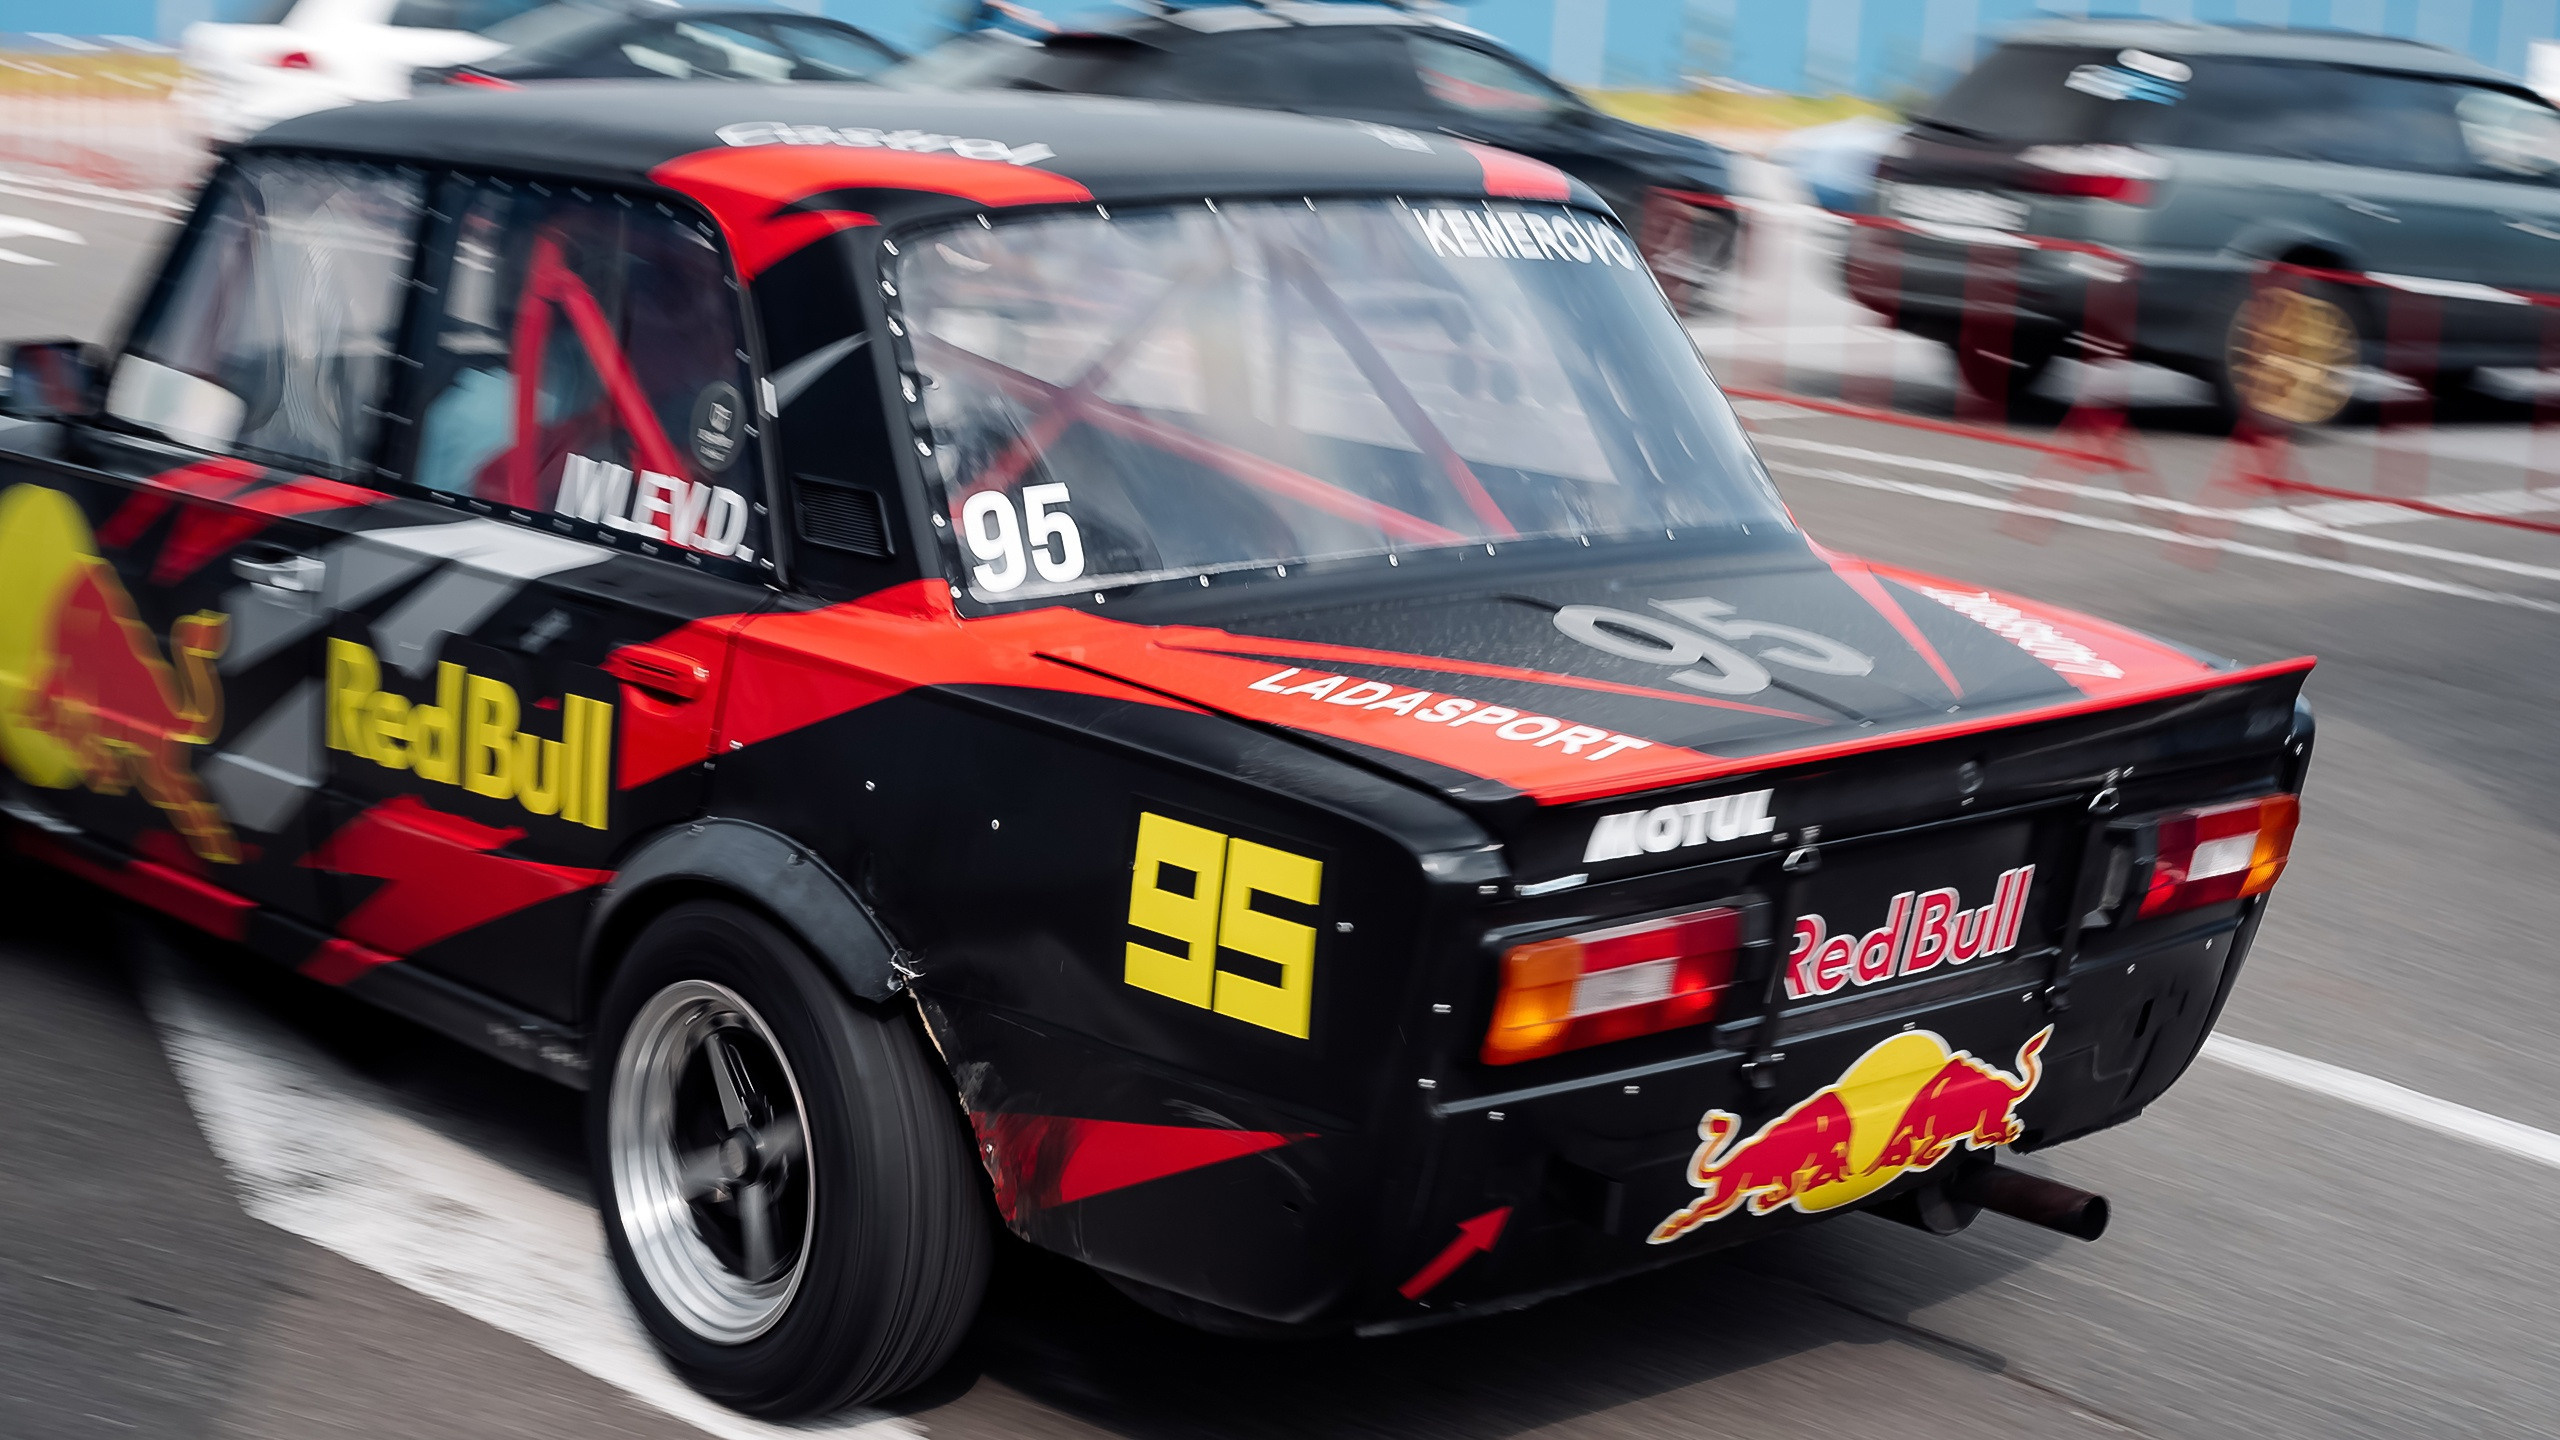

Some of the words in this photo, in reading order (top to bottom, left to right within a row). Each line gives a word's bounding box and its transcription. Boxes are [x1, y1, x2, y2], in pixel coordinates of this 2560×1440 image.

[1412, 208, 1636, 271] KEMEROVO
[962, 482, 1085, 593] 95
[1553, 596, 1875, 695] 95
[1247, 667, 1654, 761] LADASPORT
[1582, 788, 1777, 863] MOTUL
[1124, 811, 1324, 1040] 95
